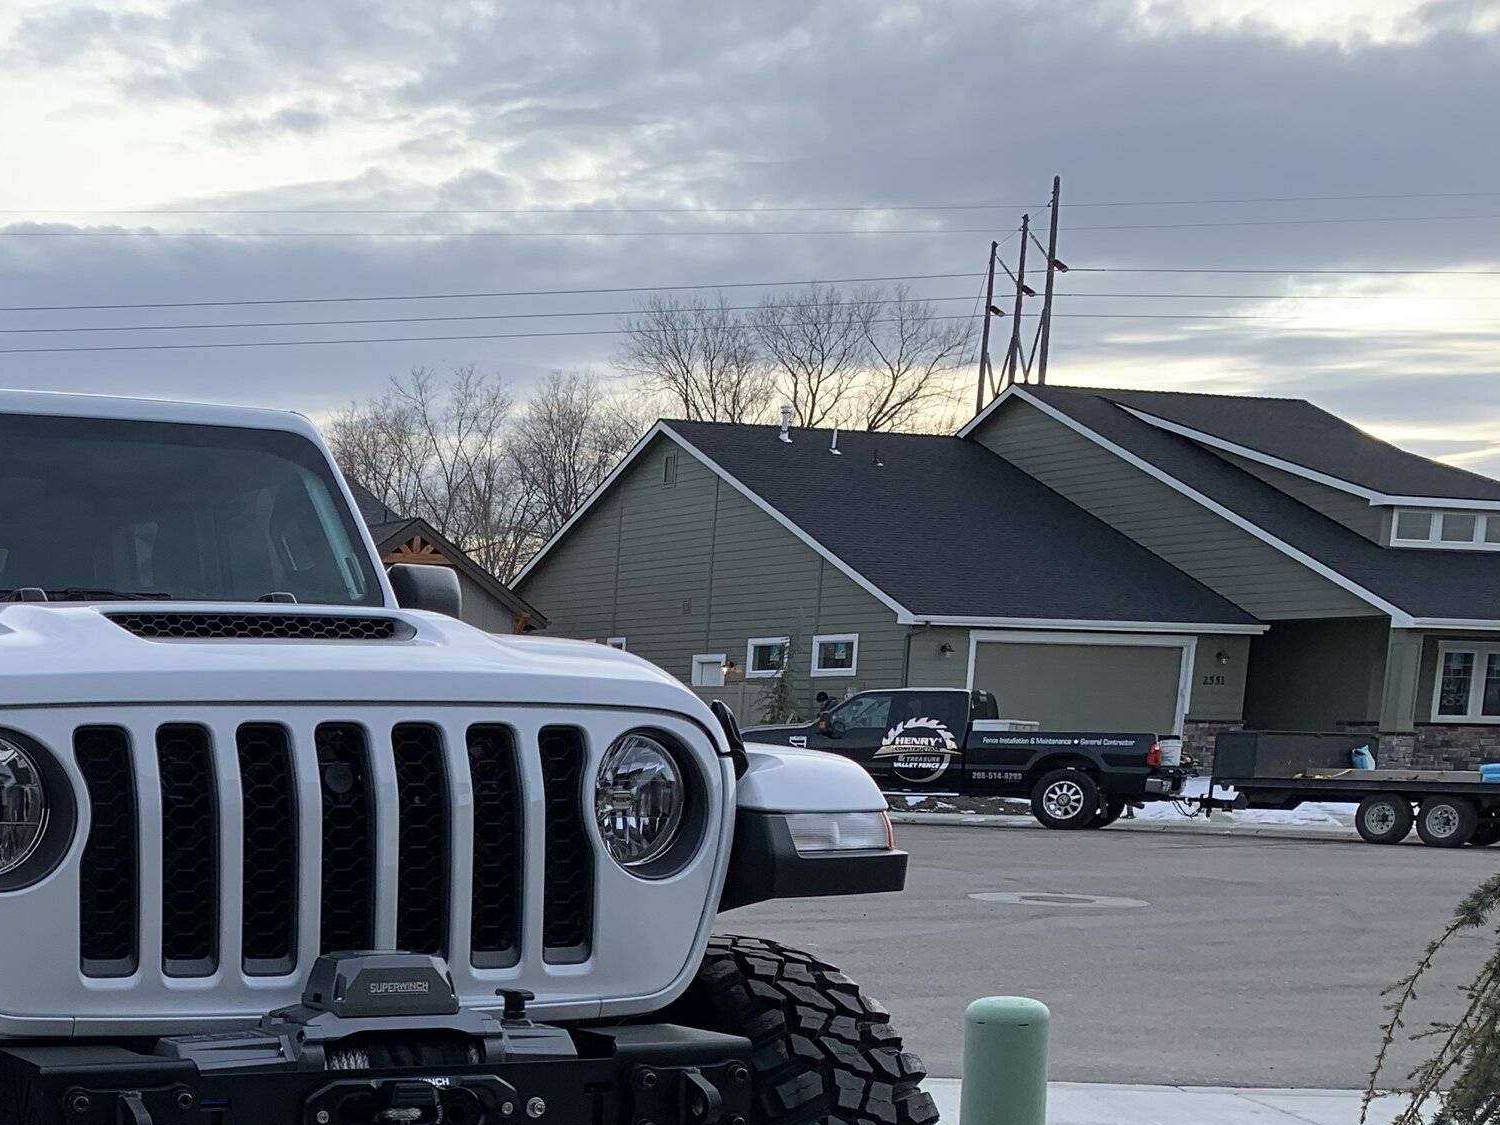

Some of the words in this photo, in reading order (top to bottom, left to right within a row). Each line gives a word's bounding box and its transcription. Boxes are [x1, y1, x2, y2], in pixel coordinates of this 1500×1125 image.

[982, 736, 998, 745] Fence
[999, 736, 1029, 745] Installation
[1030, 737, 1035, 745] &
[1102, 738, 1135, 747] Contractor
[370, 982, 429, 993] SUPERWINCH
